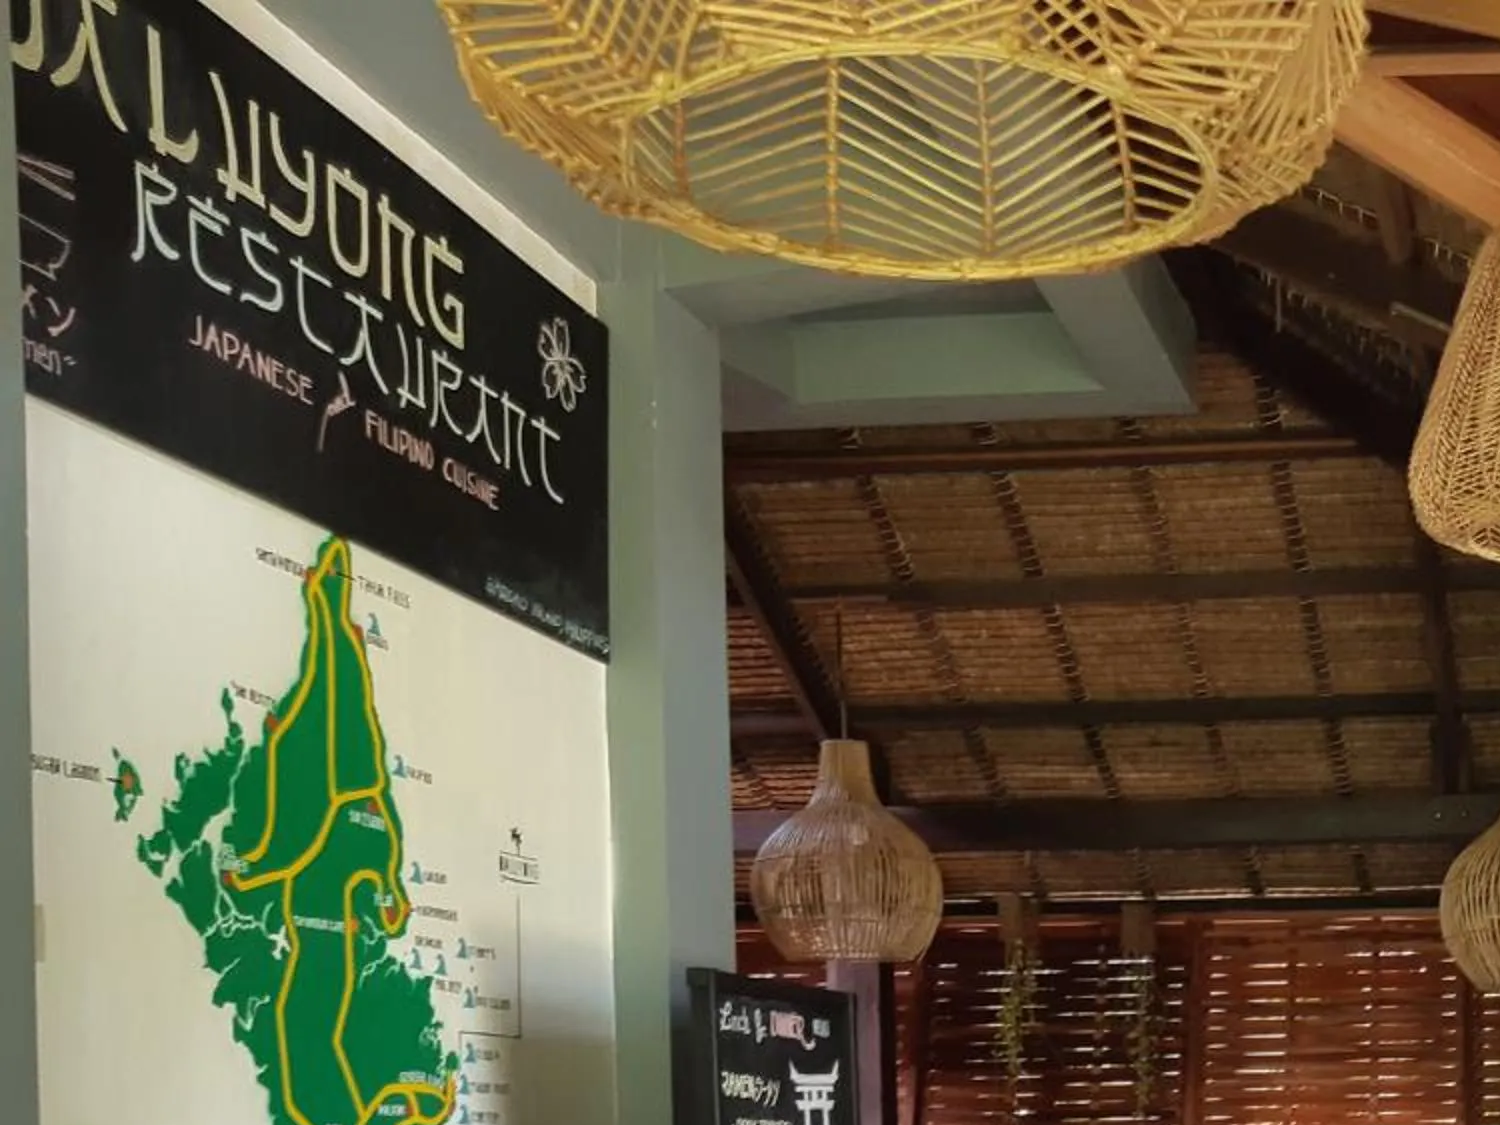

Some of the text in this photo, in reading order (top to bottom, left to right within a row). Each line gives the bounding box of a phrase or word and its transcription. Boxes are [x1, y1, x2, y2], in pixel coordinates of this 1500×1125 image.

[189, 315, 314, 406] JAPANESE
[364, 409, 435, 471] FILIPINO
[442, 457, 500, 511] CUISINE
